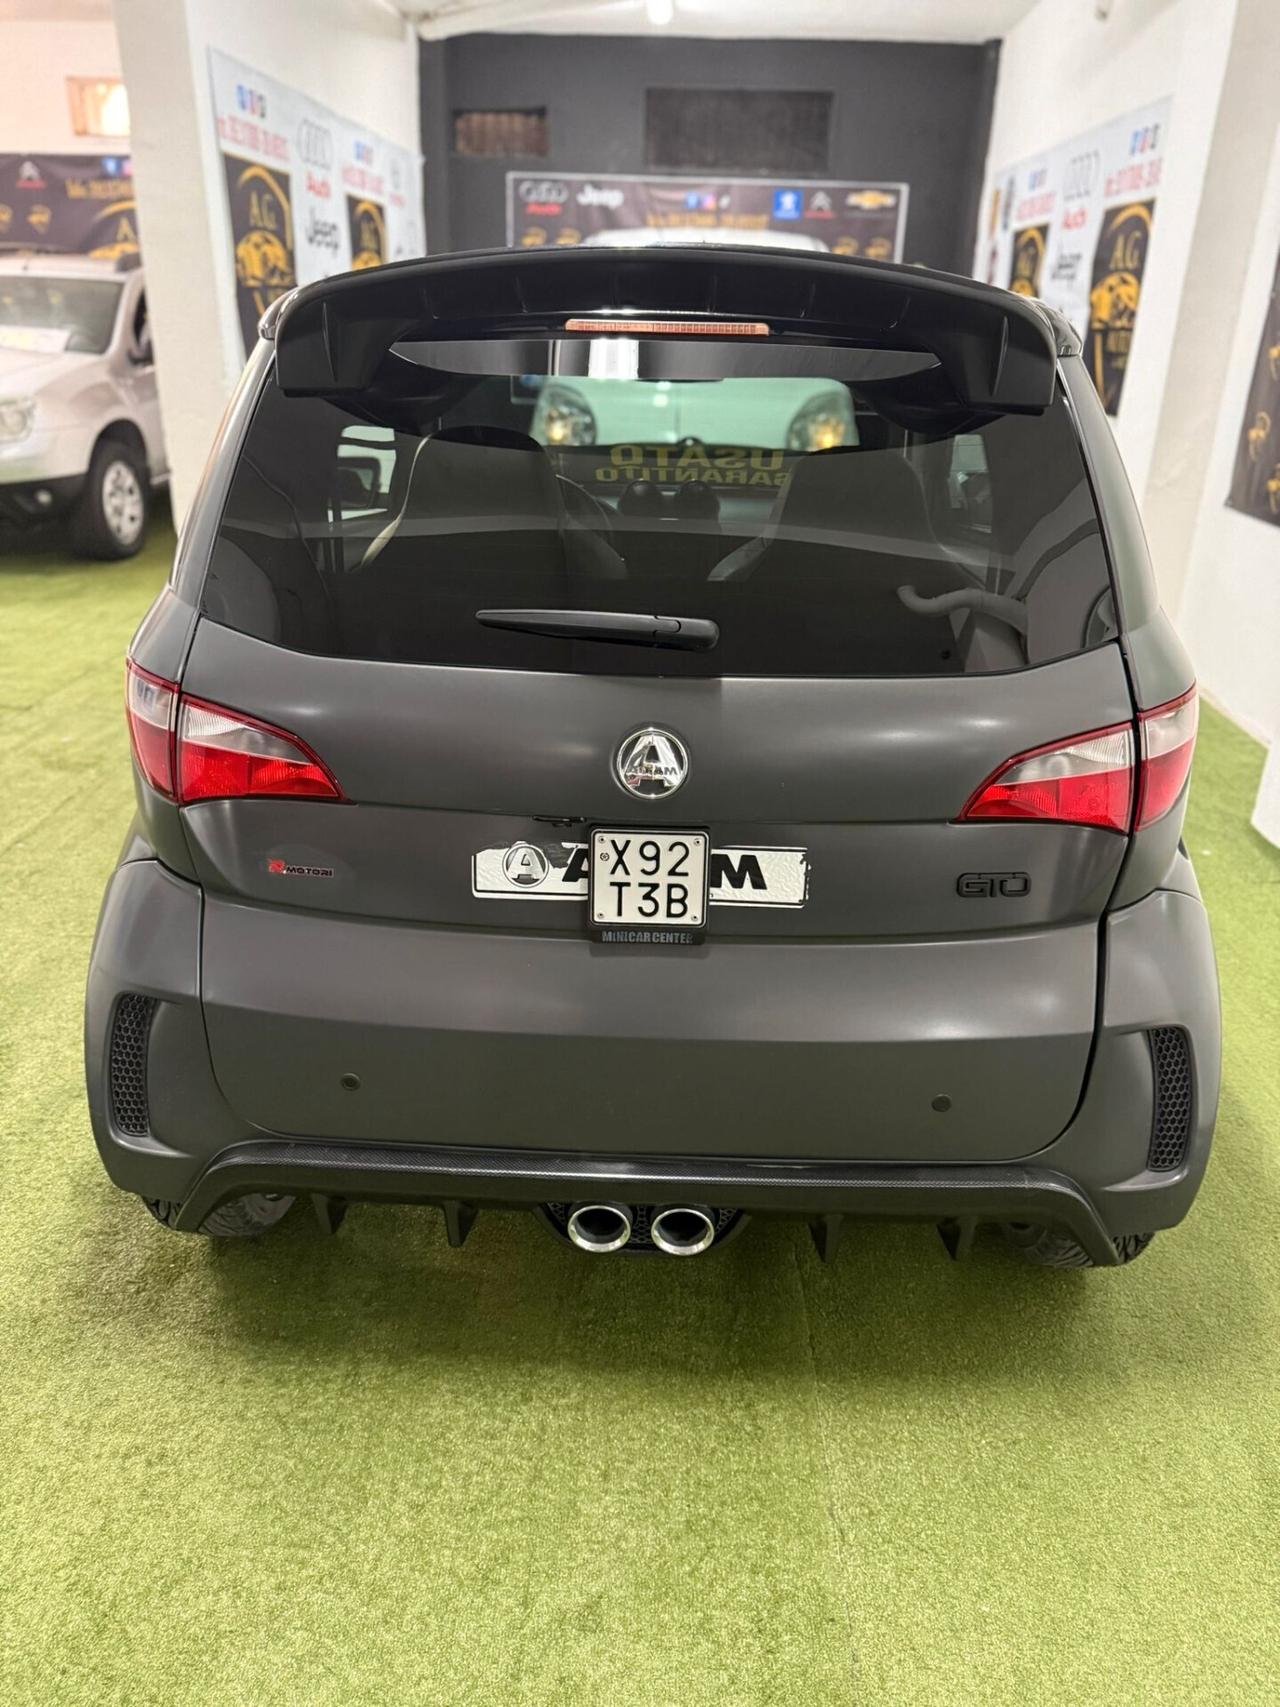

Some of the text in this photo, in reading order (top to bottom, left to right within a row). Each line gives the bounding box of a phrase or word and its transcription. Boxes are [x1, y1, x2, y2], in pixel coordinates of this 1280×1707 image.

[610, 840, 690, 876] X92
[610, 881, 690, 918] T3B
[956, 872, 1031, 898] GTO
